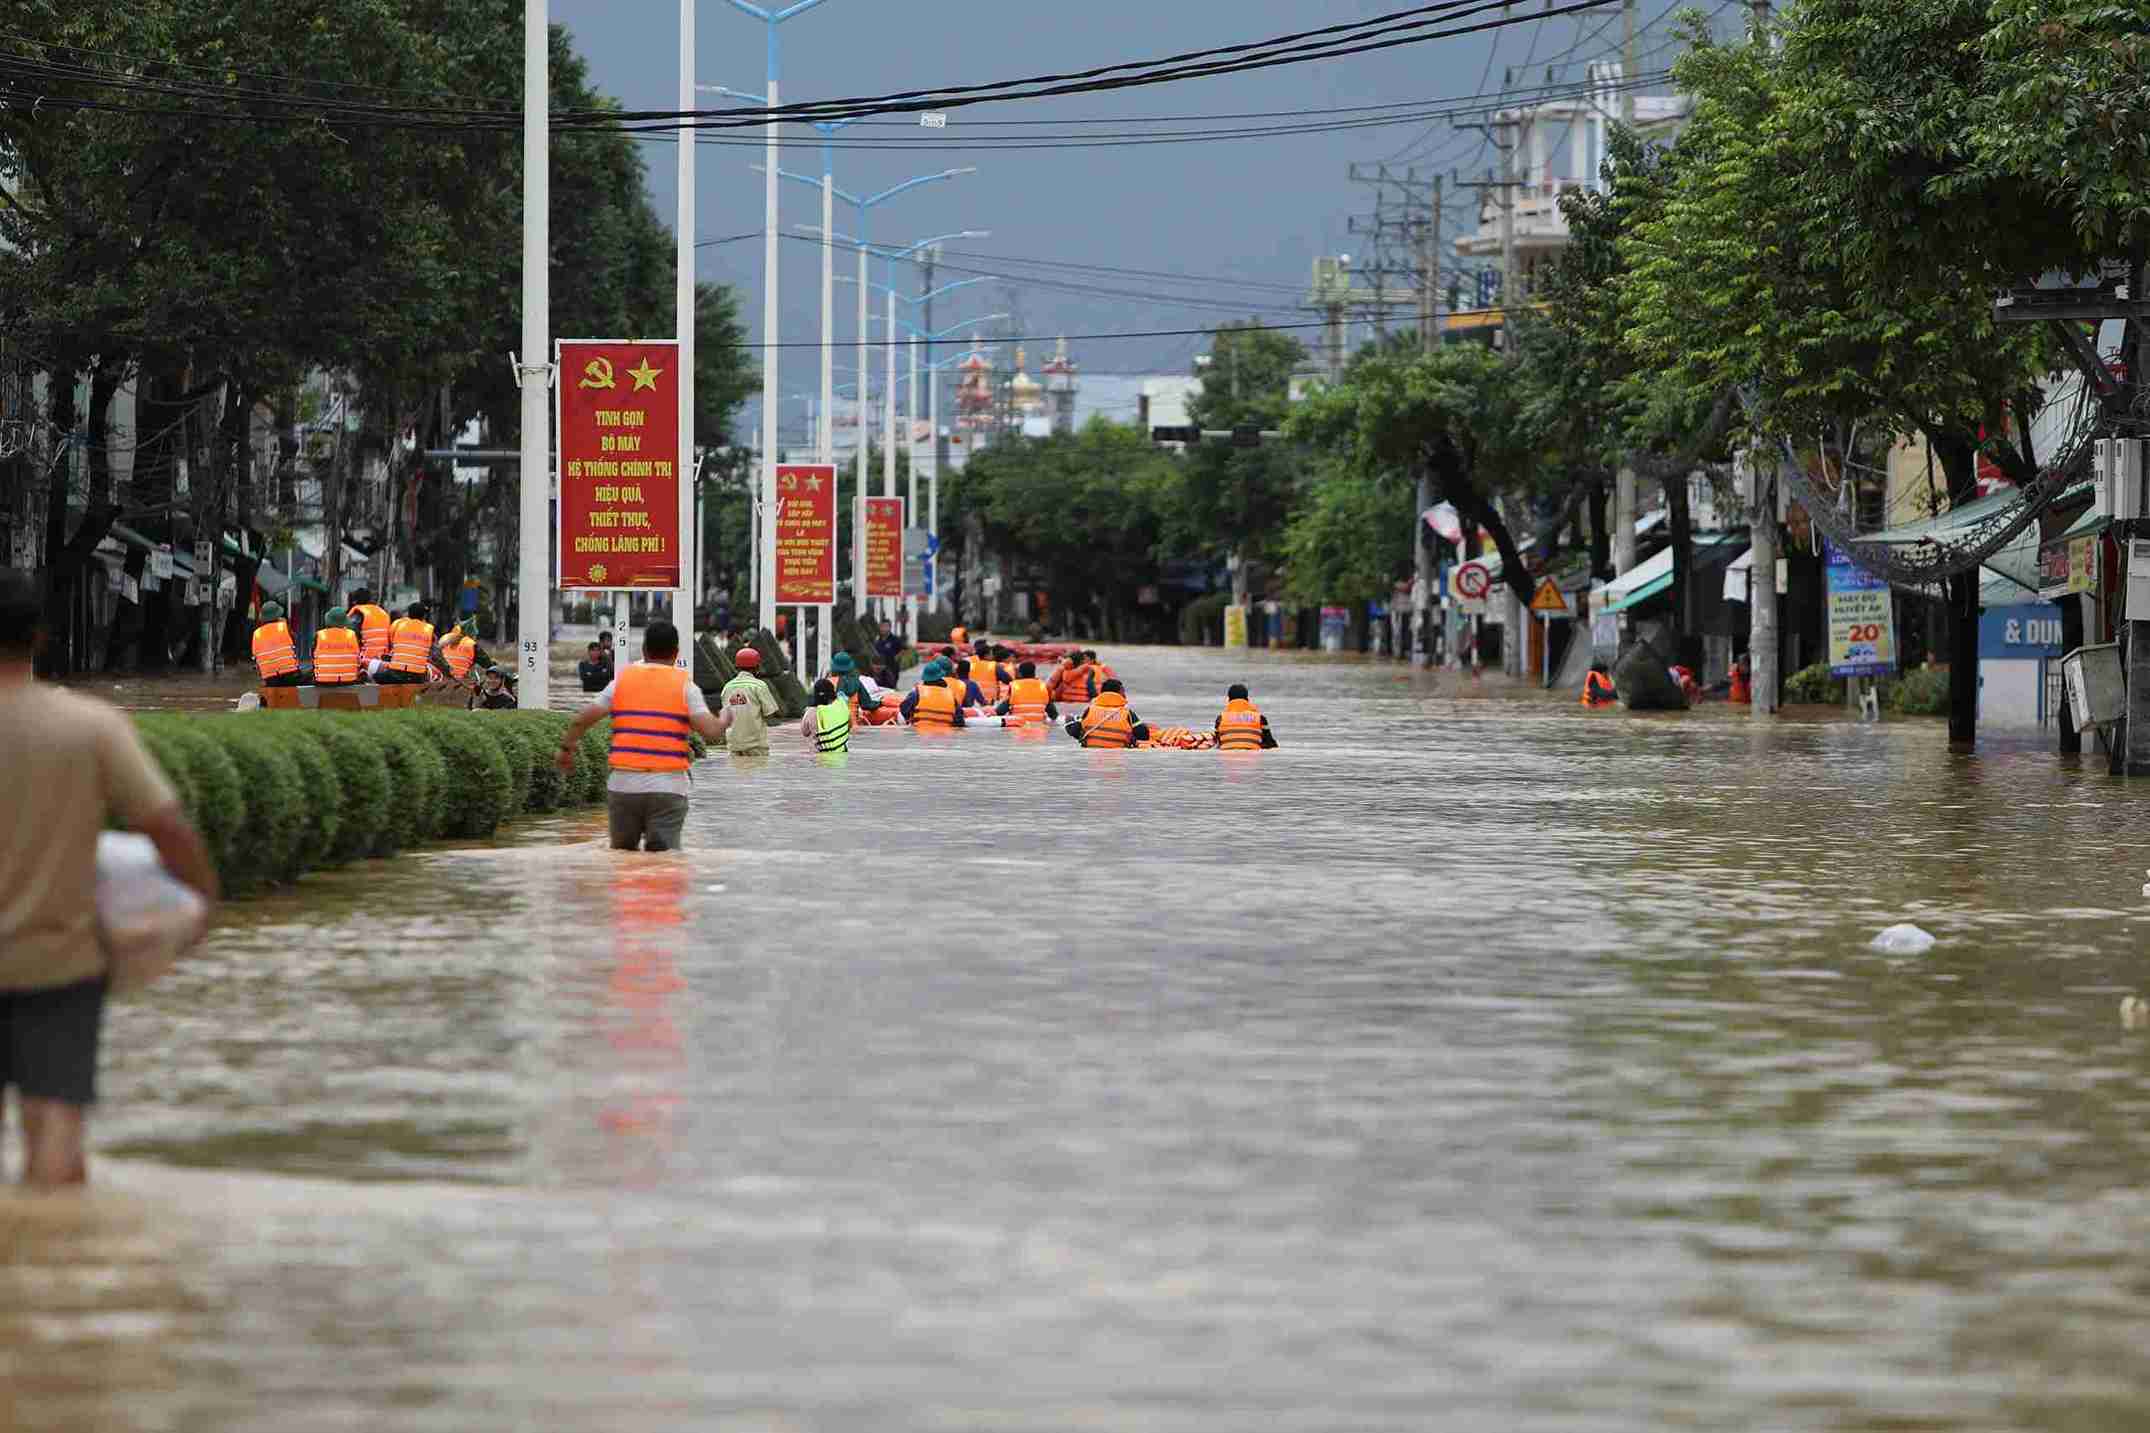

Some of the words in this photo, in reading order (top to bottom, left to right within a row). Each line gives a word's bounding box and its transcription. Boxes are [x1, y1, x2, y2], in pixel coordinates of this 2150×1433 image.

[623, 411, 645, 429] GỌN
[601, 433, 616, 455] BỘ
[617, 434, 640, 451] MÁY
[568, 458, 582, 479] HỆ
[583, 456, 618, 476] THỐNG
[620, 459, 652, 476] CHÍNH
[654, 461, 672, 479] TRỊ
[595, 484, 619, 505] HIỆU
[589, 507, 619, 527] THIẾT
[575, 531, 609, 552] CHỐNG
[611, 534, 640, 552] LÃNG
[641, 533, 660, 552] PHÍ
[2005, 618, 2020, 644] &
